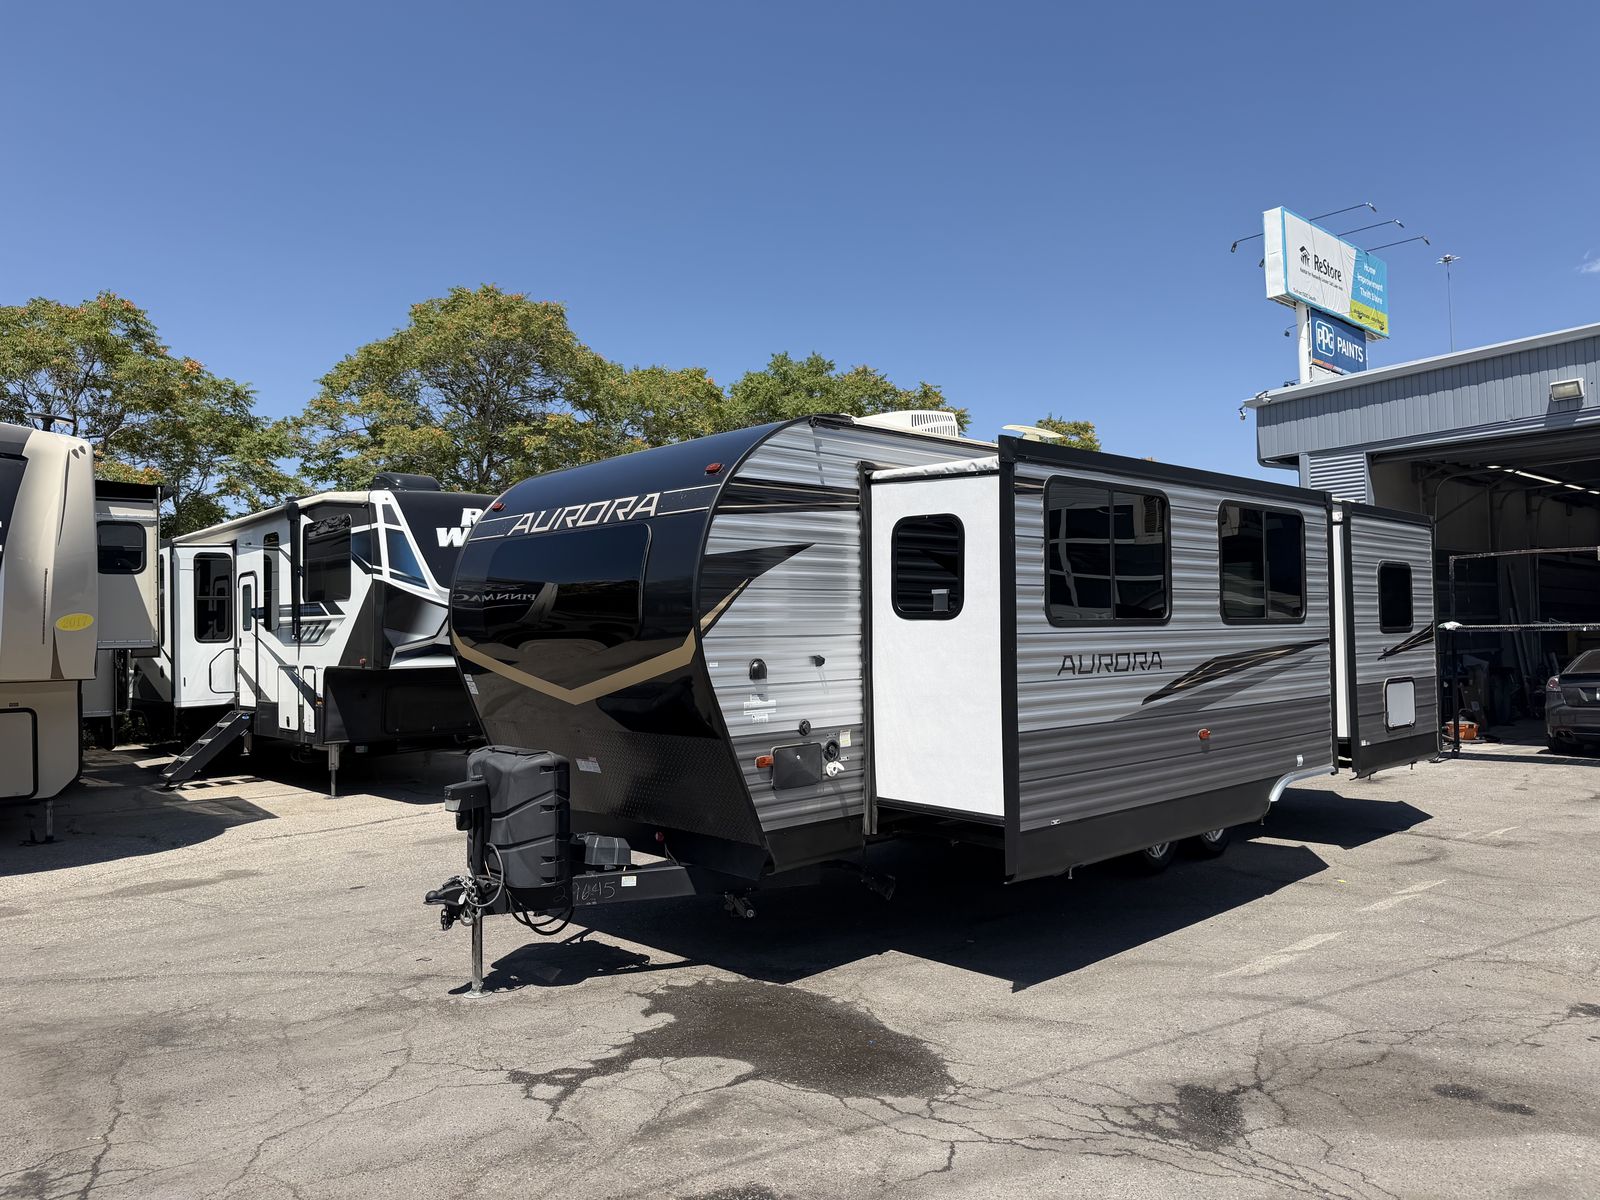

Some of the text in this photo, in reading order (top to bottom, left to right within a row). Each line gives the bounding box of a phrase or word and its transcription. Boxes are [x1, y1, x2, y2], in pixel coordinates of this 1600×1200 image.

[1314, 254, 1342, 282] ReStore
[1317, 326, 1364, 363] PPG PAINTS
[507, 492, 661, 537] AURORA
[1057, 651, 1163, 676] AURORA
